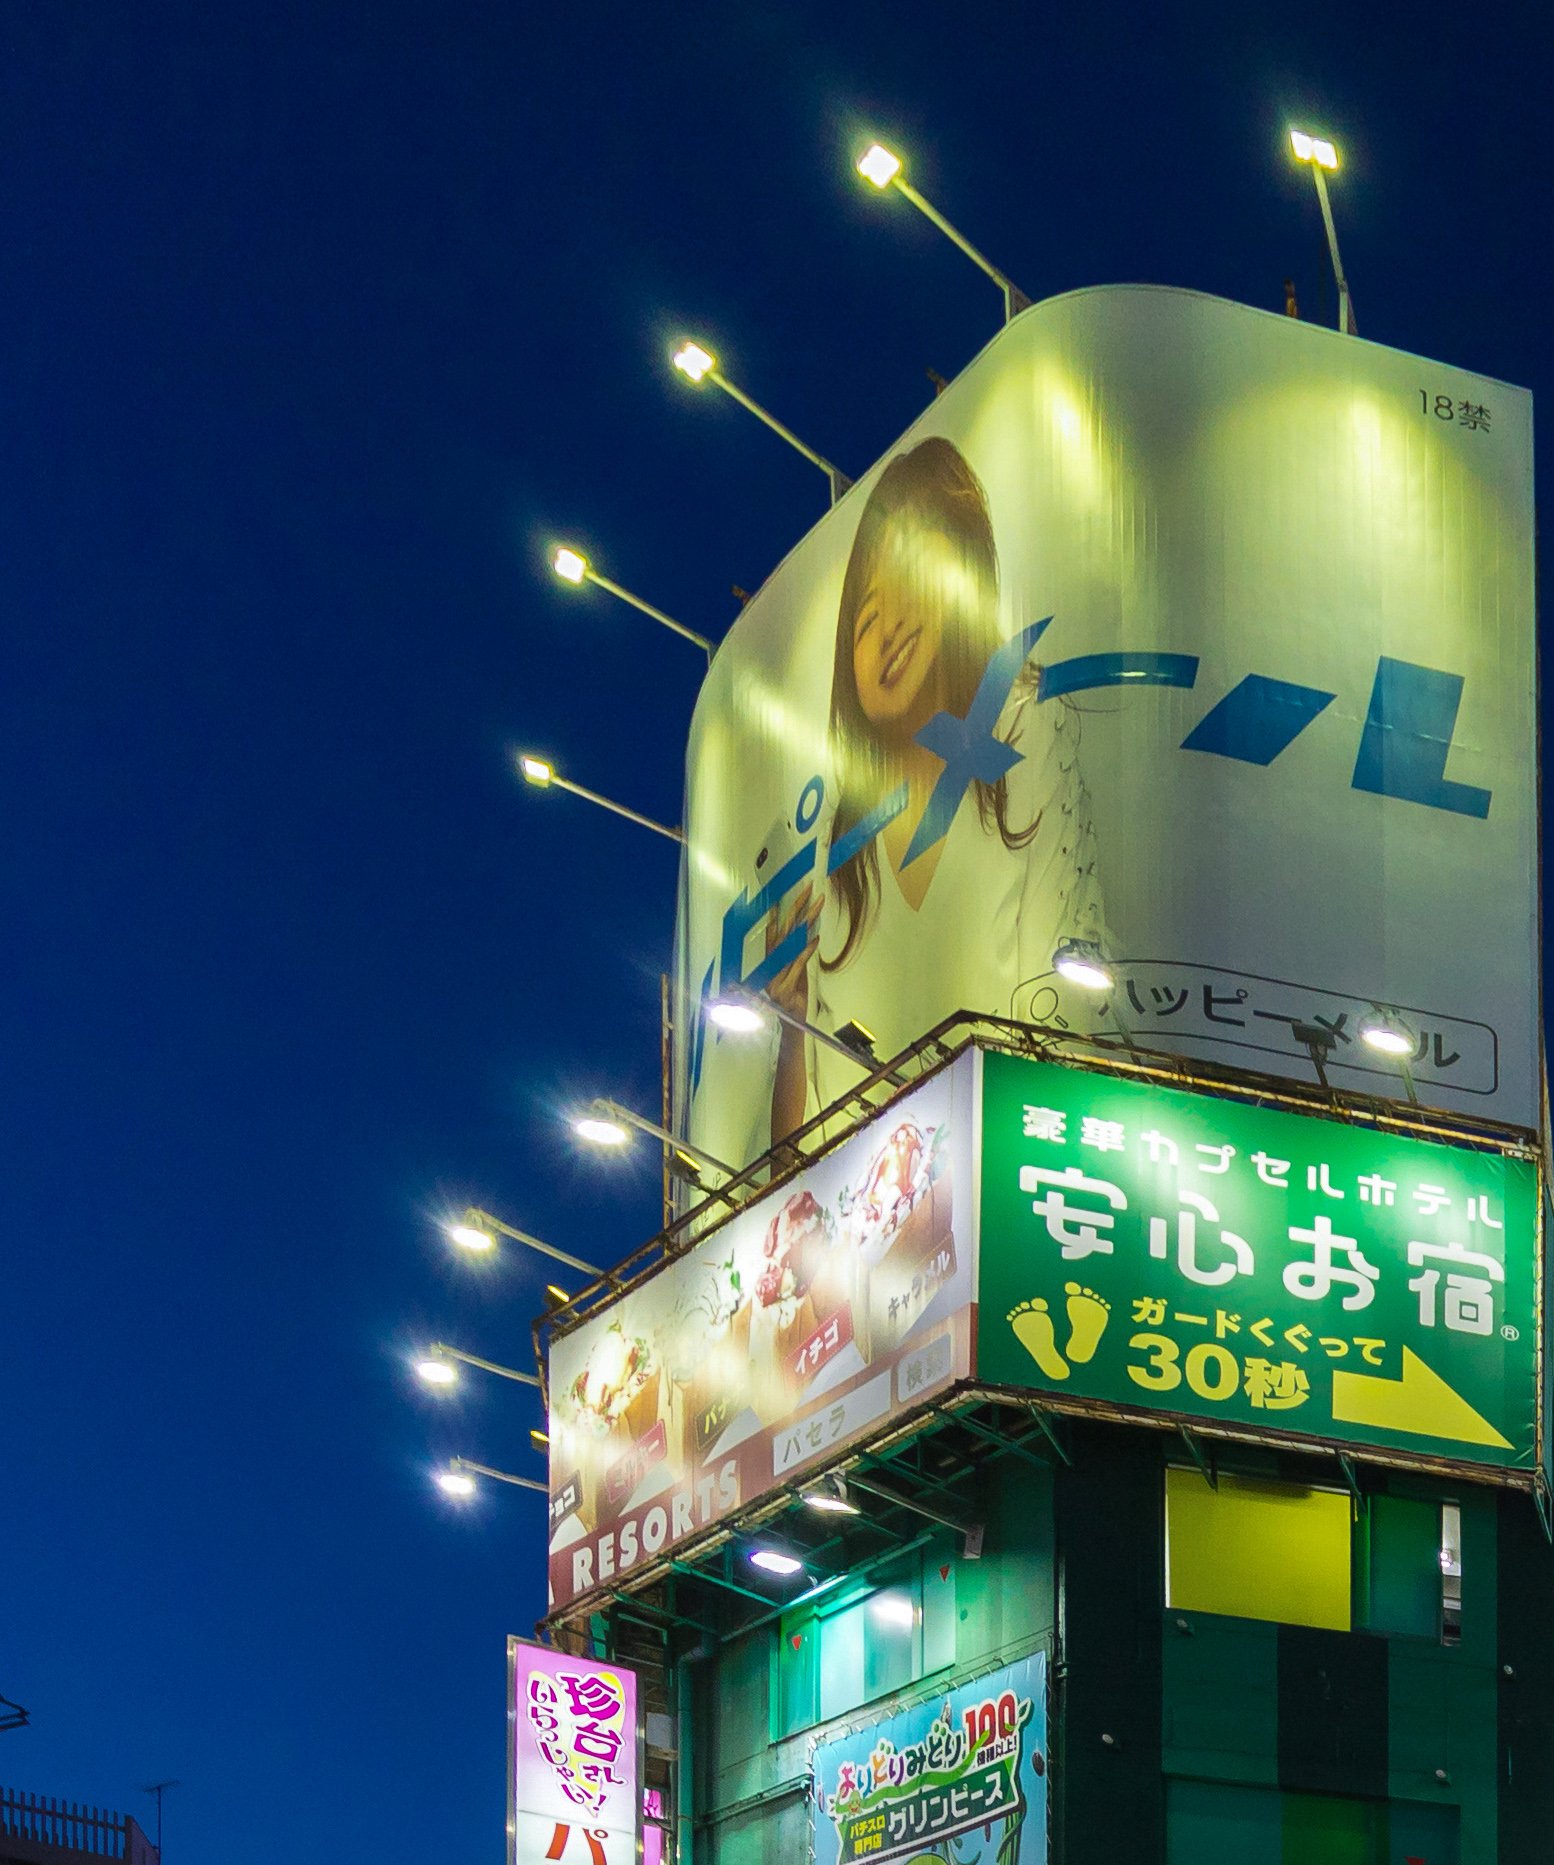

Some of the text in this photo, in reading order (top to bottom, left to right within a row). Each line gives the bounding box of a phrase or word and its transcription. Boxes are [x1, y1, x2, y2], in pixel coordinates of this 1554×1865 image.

[1417, 386, 1492, 436] 18禁
[1022, 1104, 1503, 1229] 豪華カプセルホテル
[1018, 1164, 1506, 1337] 安心お宿
[795, 1317, 839, 1375] イチゴ
[1131, 1295, 1387, 1367] ガードくぐって
[1126, 1333, 1312, 1411] 30秒
[572, 1459, 737, 1594] RESORTS
[965, 1693, 1017, 1750] 100
[888, 1770, 1004, 1841] グリンピース
